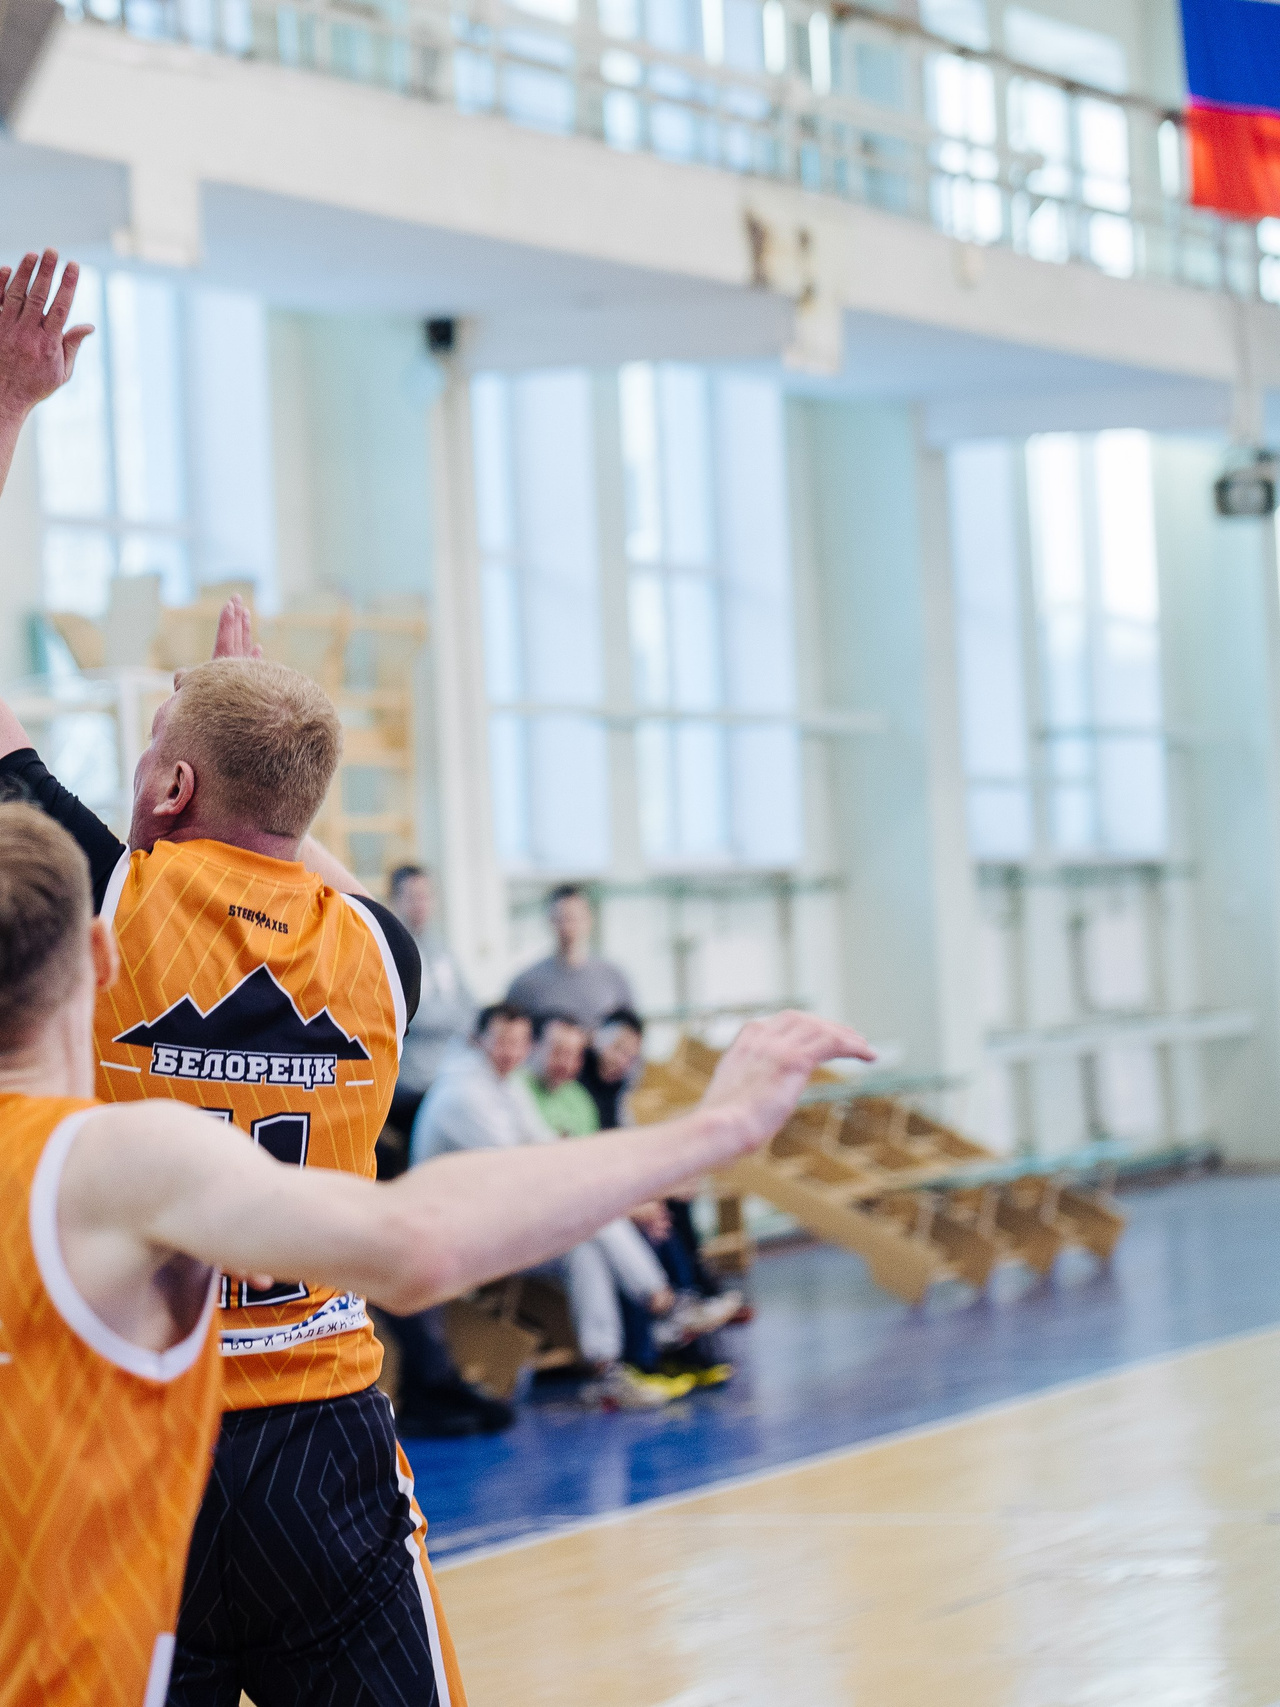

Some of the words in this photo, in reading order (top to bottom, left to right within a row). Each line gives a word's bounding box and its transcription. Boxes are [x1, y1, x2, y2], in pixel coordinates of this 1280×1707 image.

[228, 904, 255, 923] STEEL
[265, 917, 289, 934] AXES
[150, 1043, 337, 1091] БЕЛОРЕЦК
